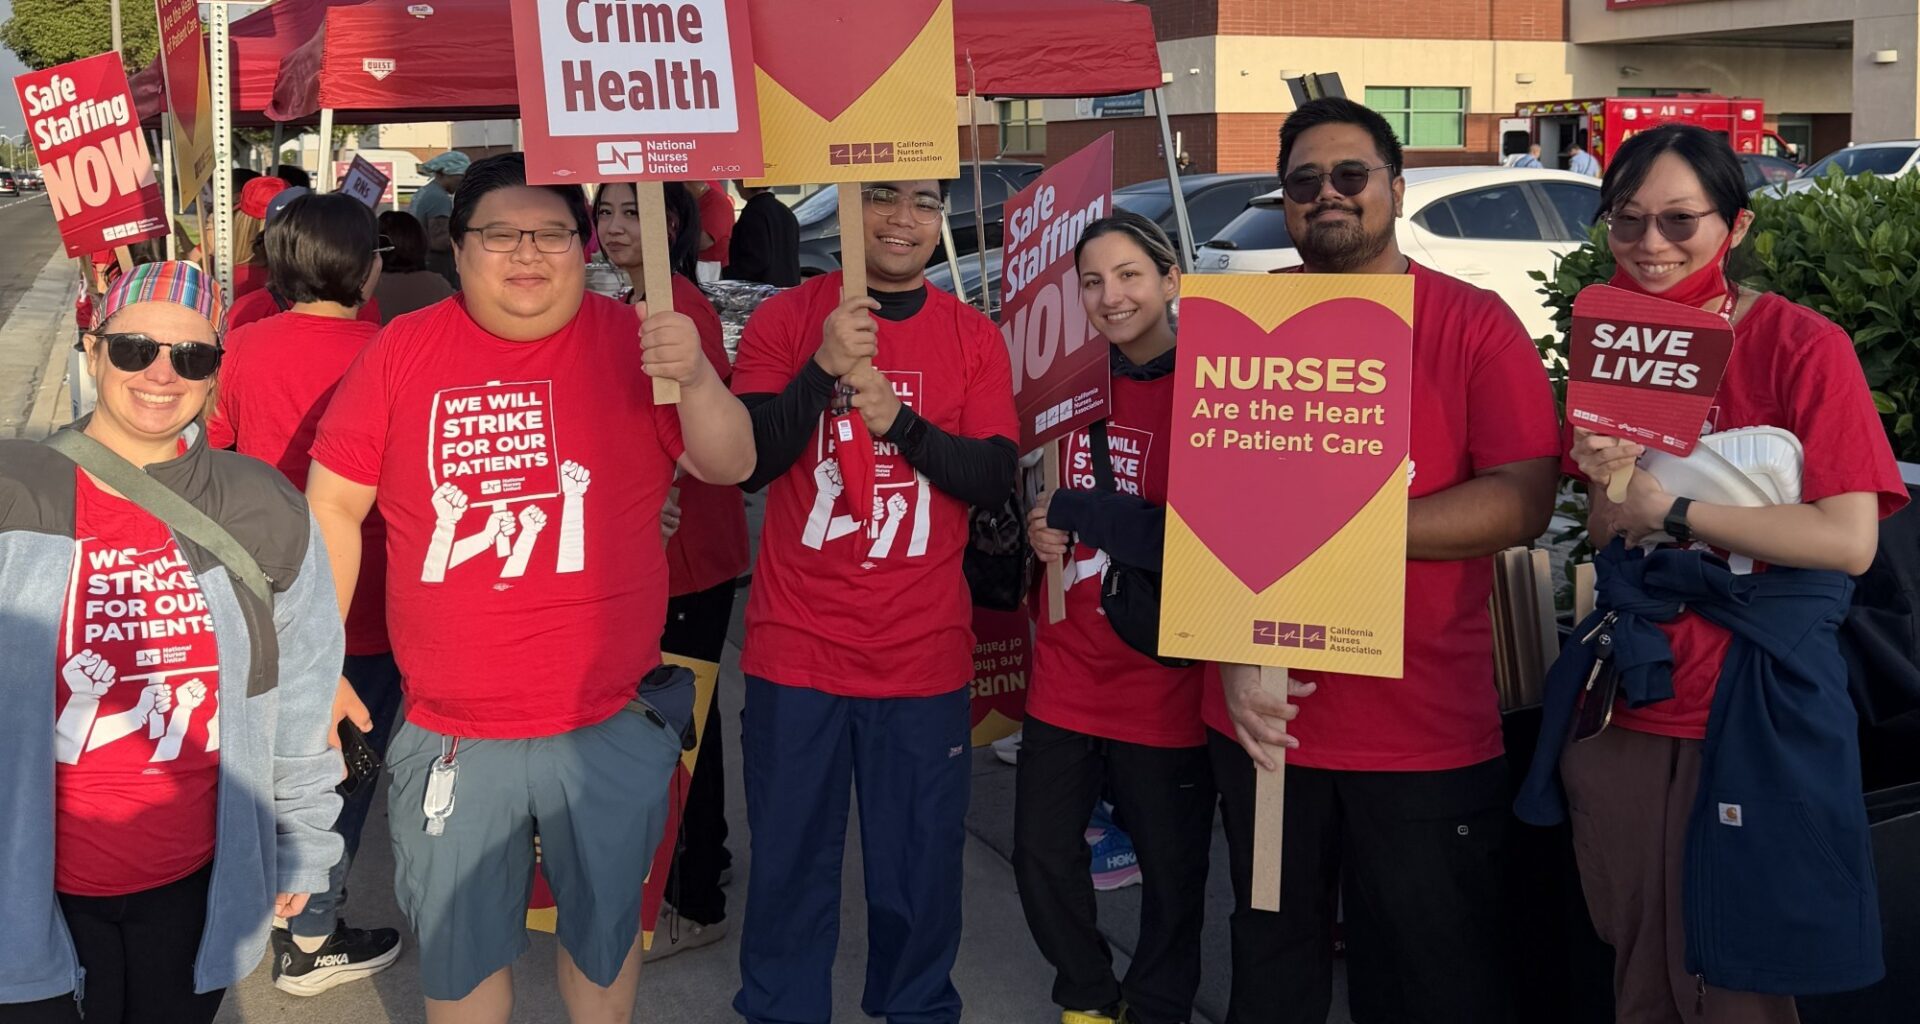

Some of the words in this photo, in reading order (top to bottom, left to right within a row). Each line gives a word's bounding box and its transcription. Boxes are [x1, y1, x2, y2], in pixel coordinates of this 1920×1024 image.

[566, 0, 704, 44] Crime
[24, 74, 78, 117] Safe
[561, 59, 720, 112] Health
[34, 93, 130, 151] Staffing
[646, 139, 697, 151] National
[896, 141, 935, 149] California
[647, 152, 689, 162] Nurses
[648, 163, 689, 174] United
[897, 155, 943, 163] Association
[41, 126, 157, 222] NOW
[1008, 184, 1056, 254] Safe
[1591, 323, 1694, 357] SAVE
[1195, 356, 1387, 394] NURSES
[1591, 354, 1701, 389] LIVES
[444, 396, 482, 415] WE
[487, 391, 543, 410] WILL
[1191, 398, 1240, 419] Are
[1249, 399, 1294, 421] the
[1304, 401, 1385, 425] Heart
[442, 410, 544, 438] STRIKE
[441, 438, 490, 460] FOR
[496, 433, 546, 453] OUR
[1190, 428, 1216, 448] of
[1223, 429, 1313, 452] Patient
[1322, 433, 1384, 456] Care
[442, 452, 549, 478] PATIENTS
[1072, 473, 1097, 489] FO
[88, 548, 138, 571] WE
[85, 599, 148, 619] FOR
[1329, 626, 1374, 638] California
[1329, 635, 1361, 645] Nurses
[976, 640, 1007, 656] Patie
[1329, 643, 1383, 656] Association
[974, 658, 997, 672] the
[1000, 653, 1024, 667] Are
[313, 953, 350, 968] HOKA
